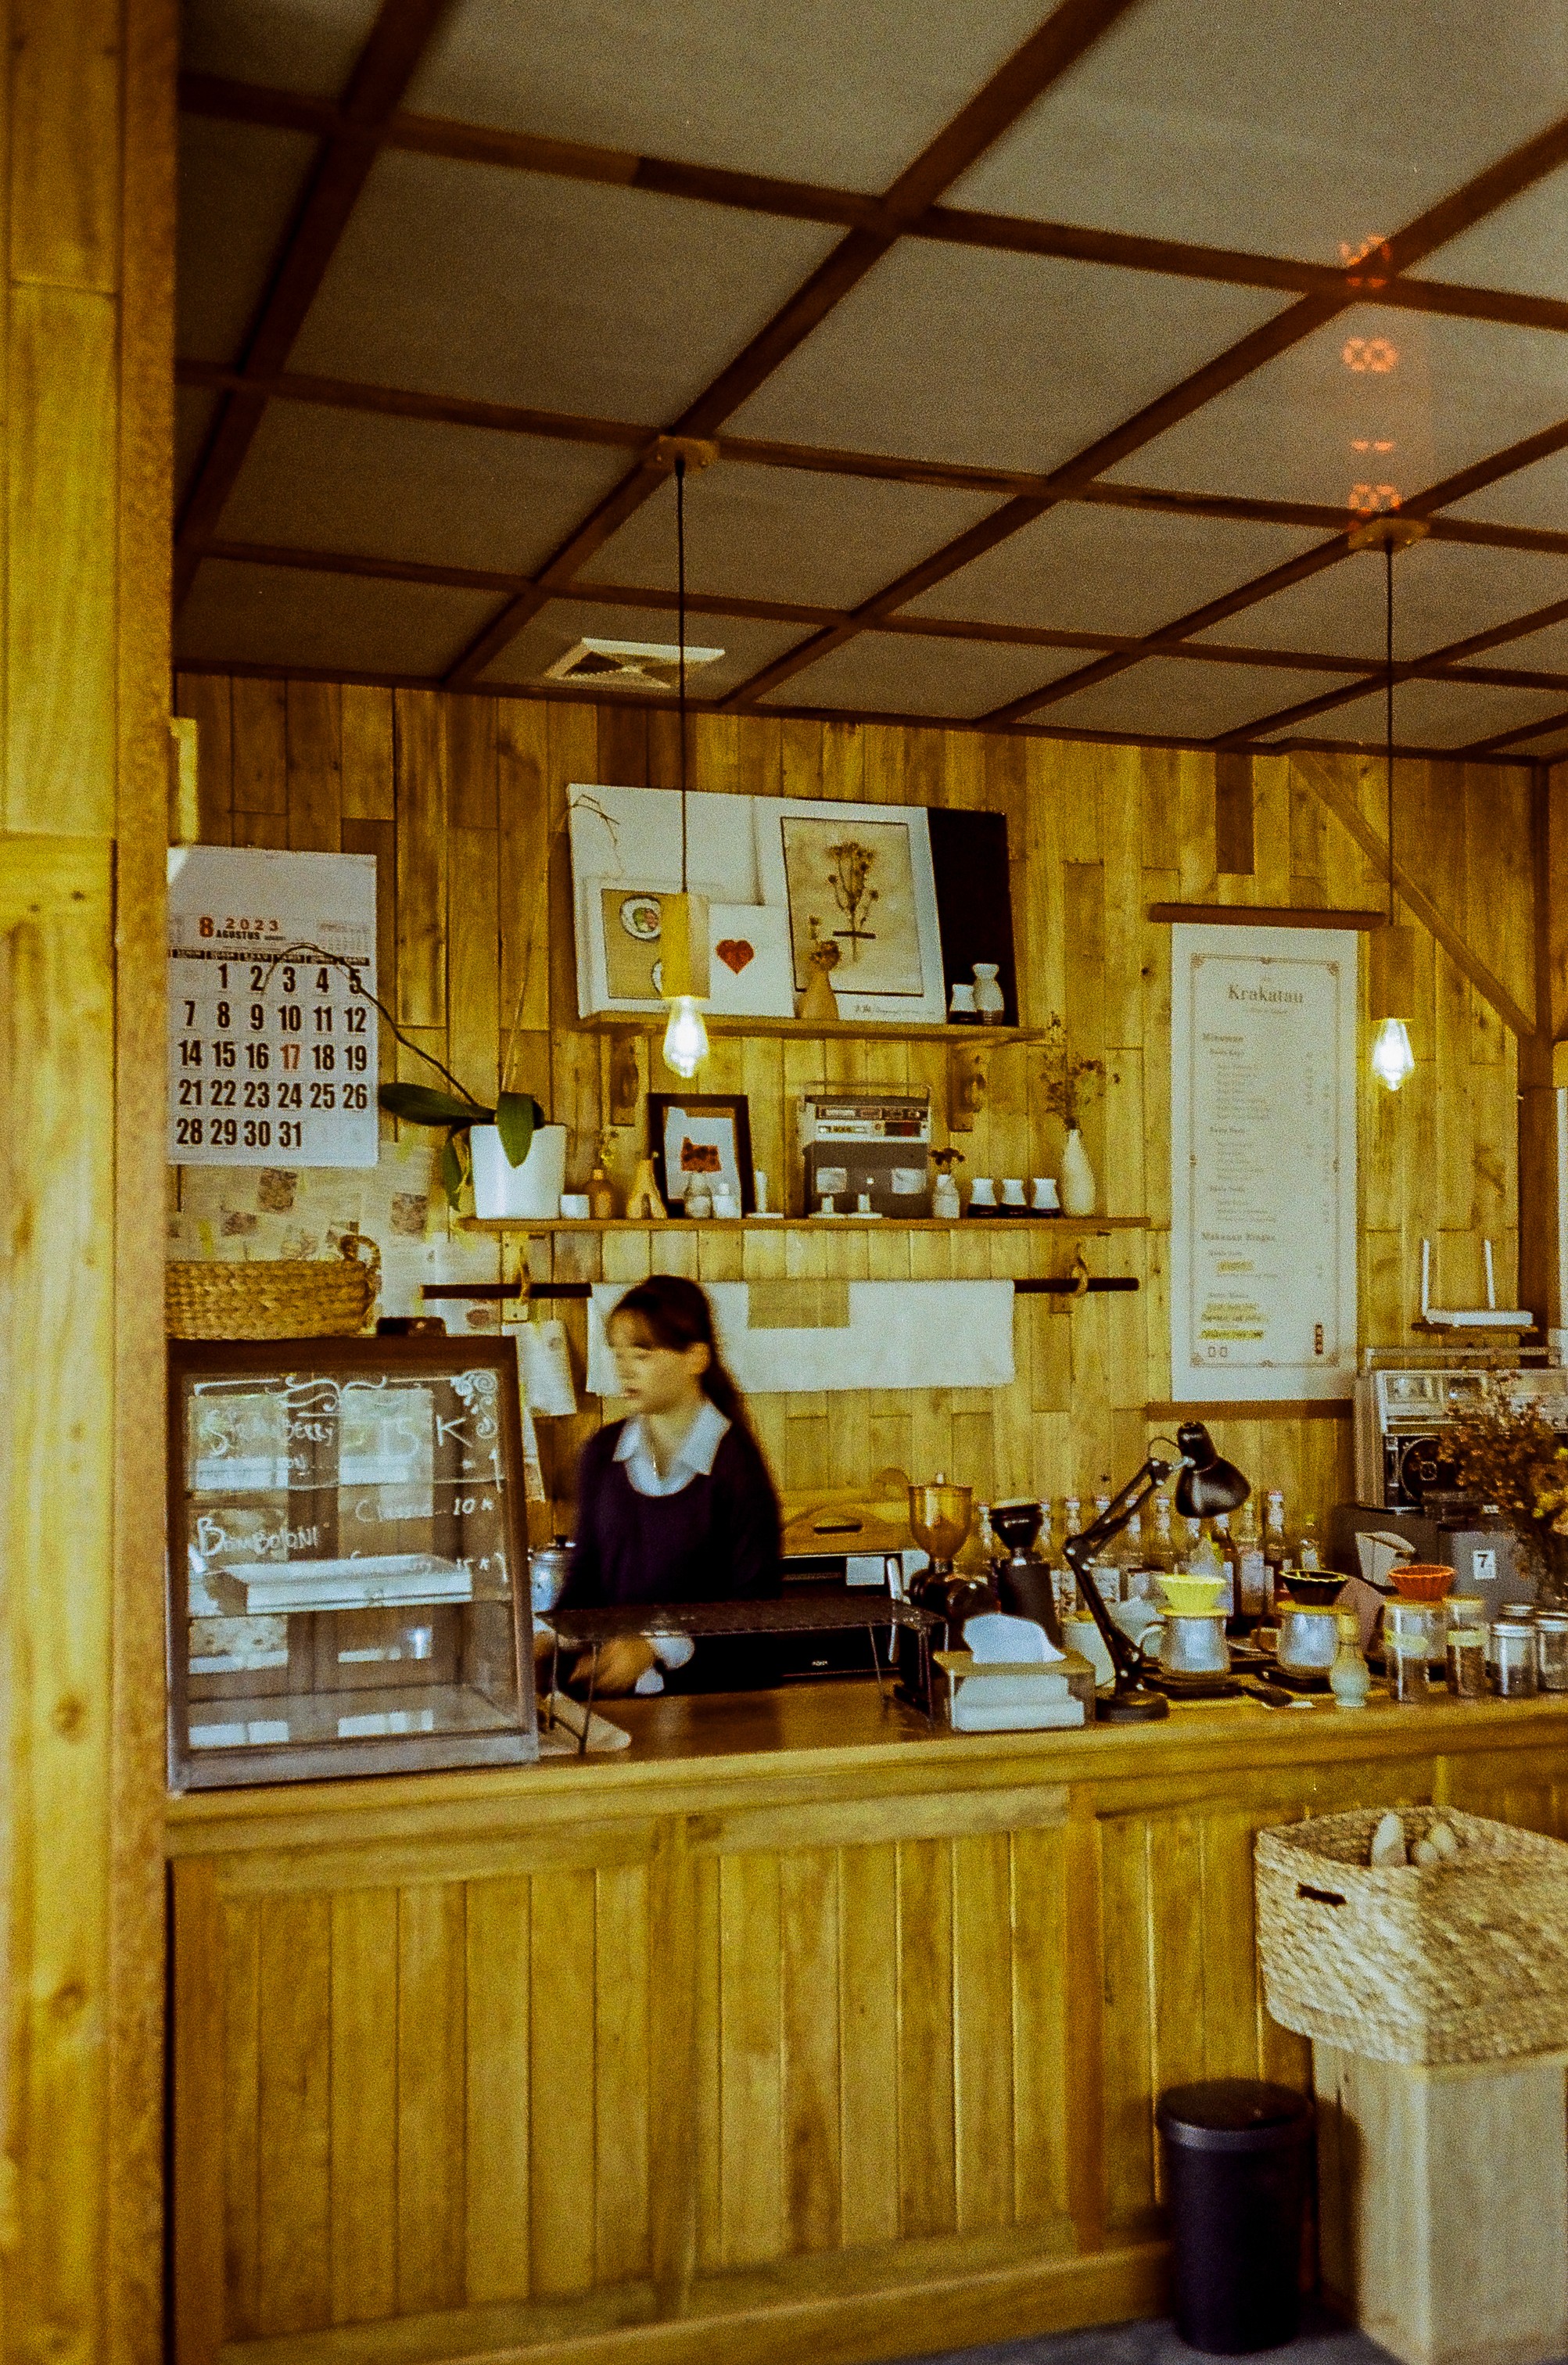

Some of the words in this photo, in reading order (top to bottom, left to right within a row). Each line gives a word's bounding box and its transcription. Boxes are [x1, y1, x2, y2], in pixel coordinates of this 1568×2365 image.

[199, 916, 214, 938] 8
[224, 917, 280, 931] 2023
[216, 929, 260, 940] AGUSTUS
[217, 963, 228, 989] 1
[249, 965, 264, 992] 2
[282, 966, 296, 994] 3
[315, 967, 329, 993] 4
[350, 967, 363, 994] 5
[1228, 983, 1304, 1003] Krakatau
[183, 999, 196, 1027] 7
[217, 1000, 231, 1028] 8
[250, 1003, 264, 1031] 9
[278, 1004, 302, 1032] 10
[313, 1006, 332, 1032] 11
[344, 1007, 367, 1033] 12
[178, 1039, 202, 1067] 14
[211, 1040, 236, 1068] 15
[245, 1043, 270, 1070] 16
[281, 1043, 300, 1071] 17
[312, 1044, 335, 1071] 18
[344, 1045, 367, 1071] 19
[178, 1078, 203, 1106] 21
[210, 1079, 237, 1107] 22
[243, 1081, 270, 1108] 23
[277, 1082, 303, 1109] 24
[310, 1082, 335, 1109] 25
[343, 1083, 368, 1110] 26
[176, 1118, 203, 1145] 28
[210, 1118, 238, 1146] 29
[243, 1120, 271, 1147] 30
[278, 1121, 302, 1148] 31
[436, 1414, 472, 1448] K
[453, 1497, 476, 1516] 10
[1477, 1554, 1489, 1568] 7
